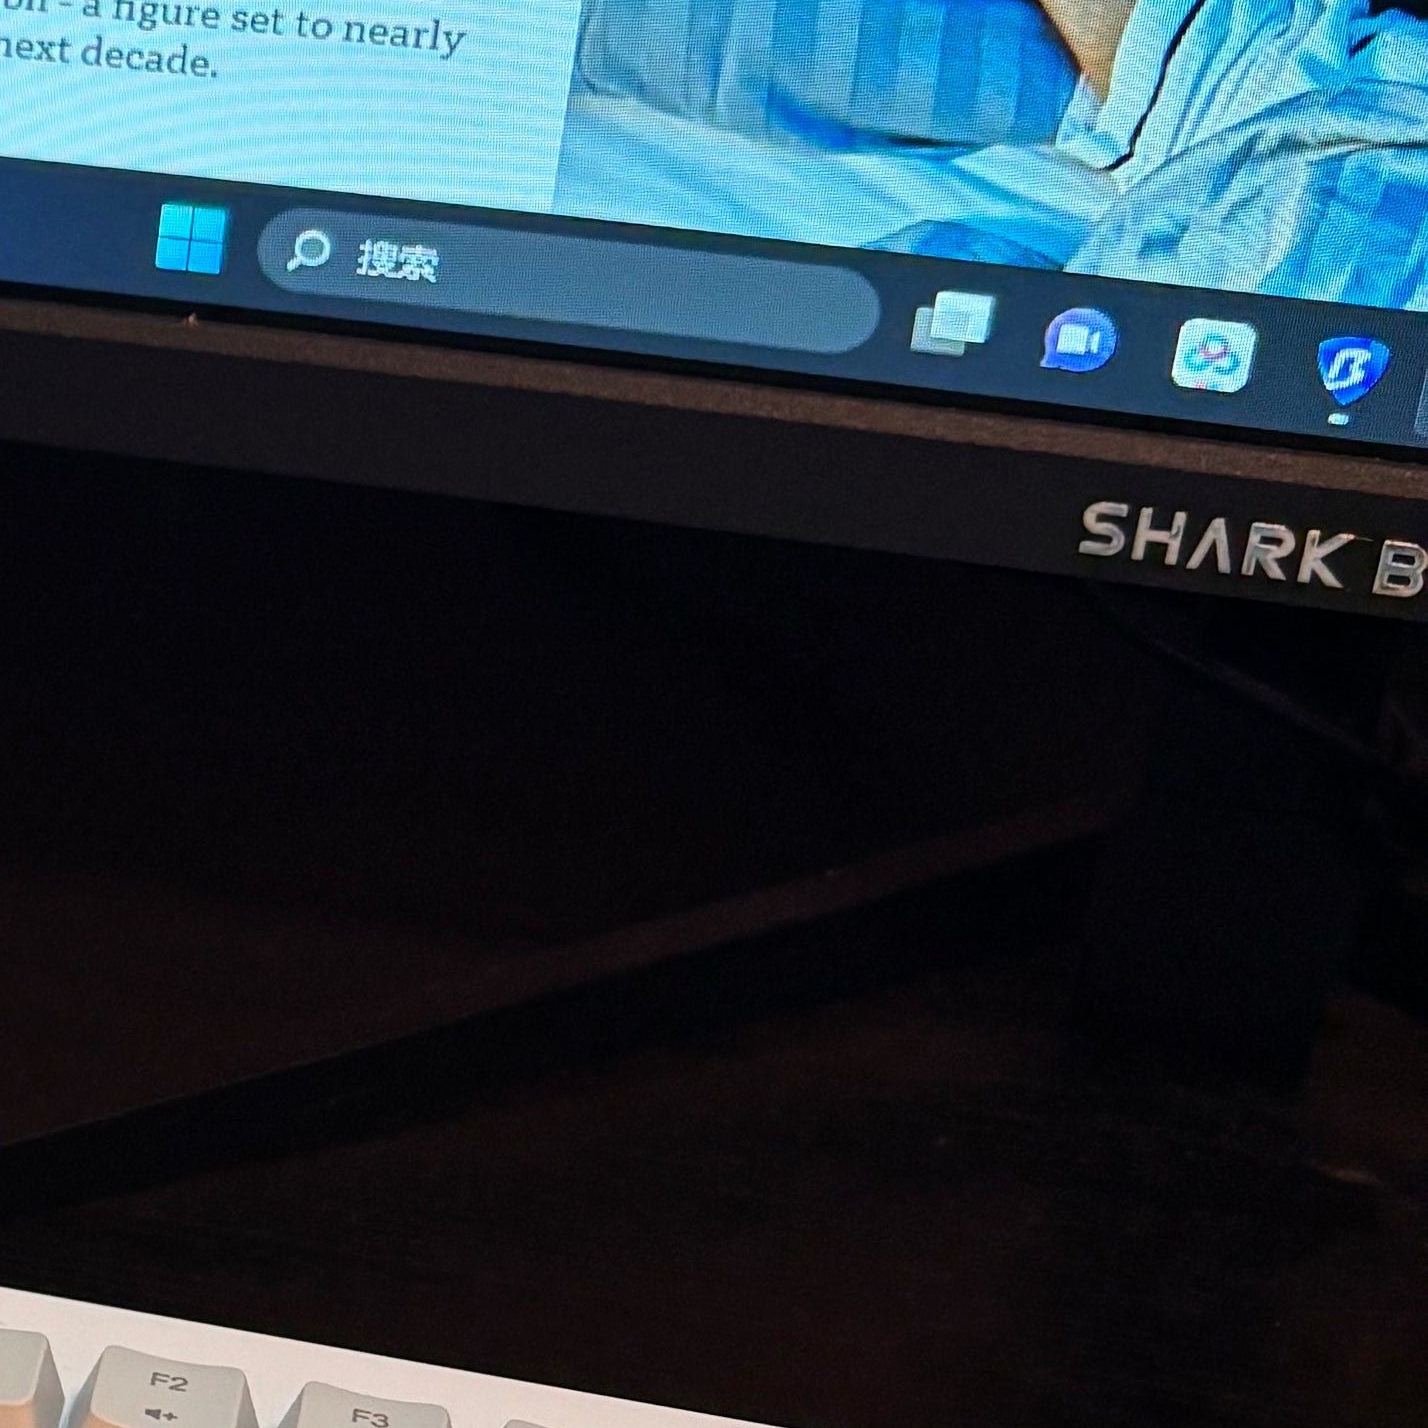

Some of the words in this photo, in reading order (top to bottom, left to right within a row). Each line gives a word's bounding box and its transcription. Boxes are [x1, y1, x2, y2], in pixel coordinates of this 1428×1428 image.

[80, 31, 219, 78] decade.
[230, 5, 284, 35] set
[296, 10, 333, 39] to
[342, 14, 467, 60] nearly
[355, 237, 441, 284] 搜索
[1078, 501, 1358, 588] SHARK
[150, 1371, 189, 1393] F2
[351, 1407, 390, 1428] F3
